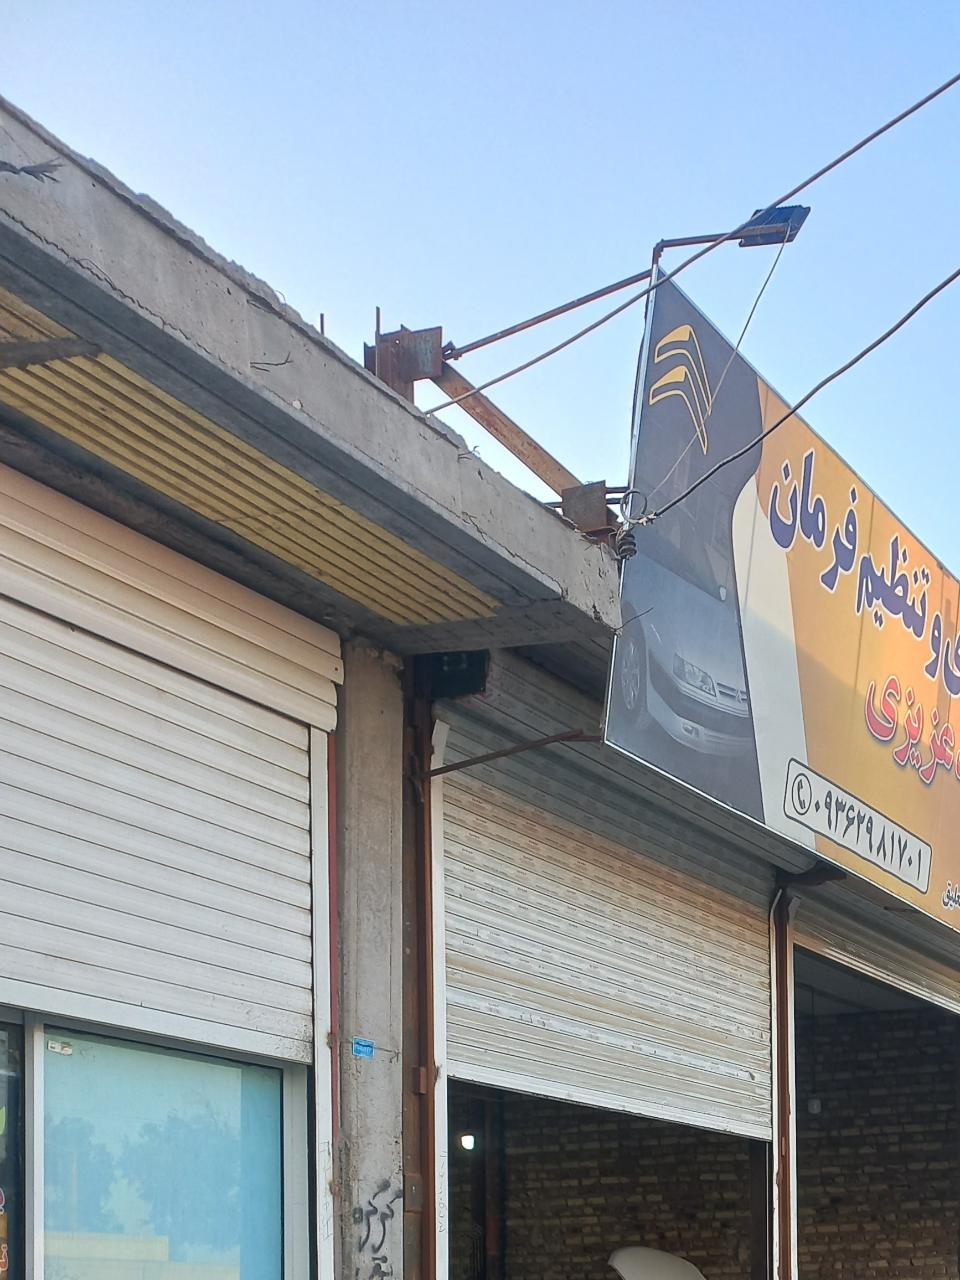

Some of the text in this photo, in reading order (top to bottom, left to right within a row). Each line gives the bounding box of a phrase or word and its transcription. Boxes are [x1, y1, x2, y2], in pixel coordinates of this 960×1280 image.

[769, 450, 858, 592] فرمان
[856, 535, 931, 638] تنظیم
[925, 613, 942, 679] و
[865, 675, 955, 785] عزیزی
[815, 790, 922, 882] ۰۹۳۶۲۹۸۱۷۰۱
